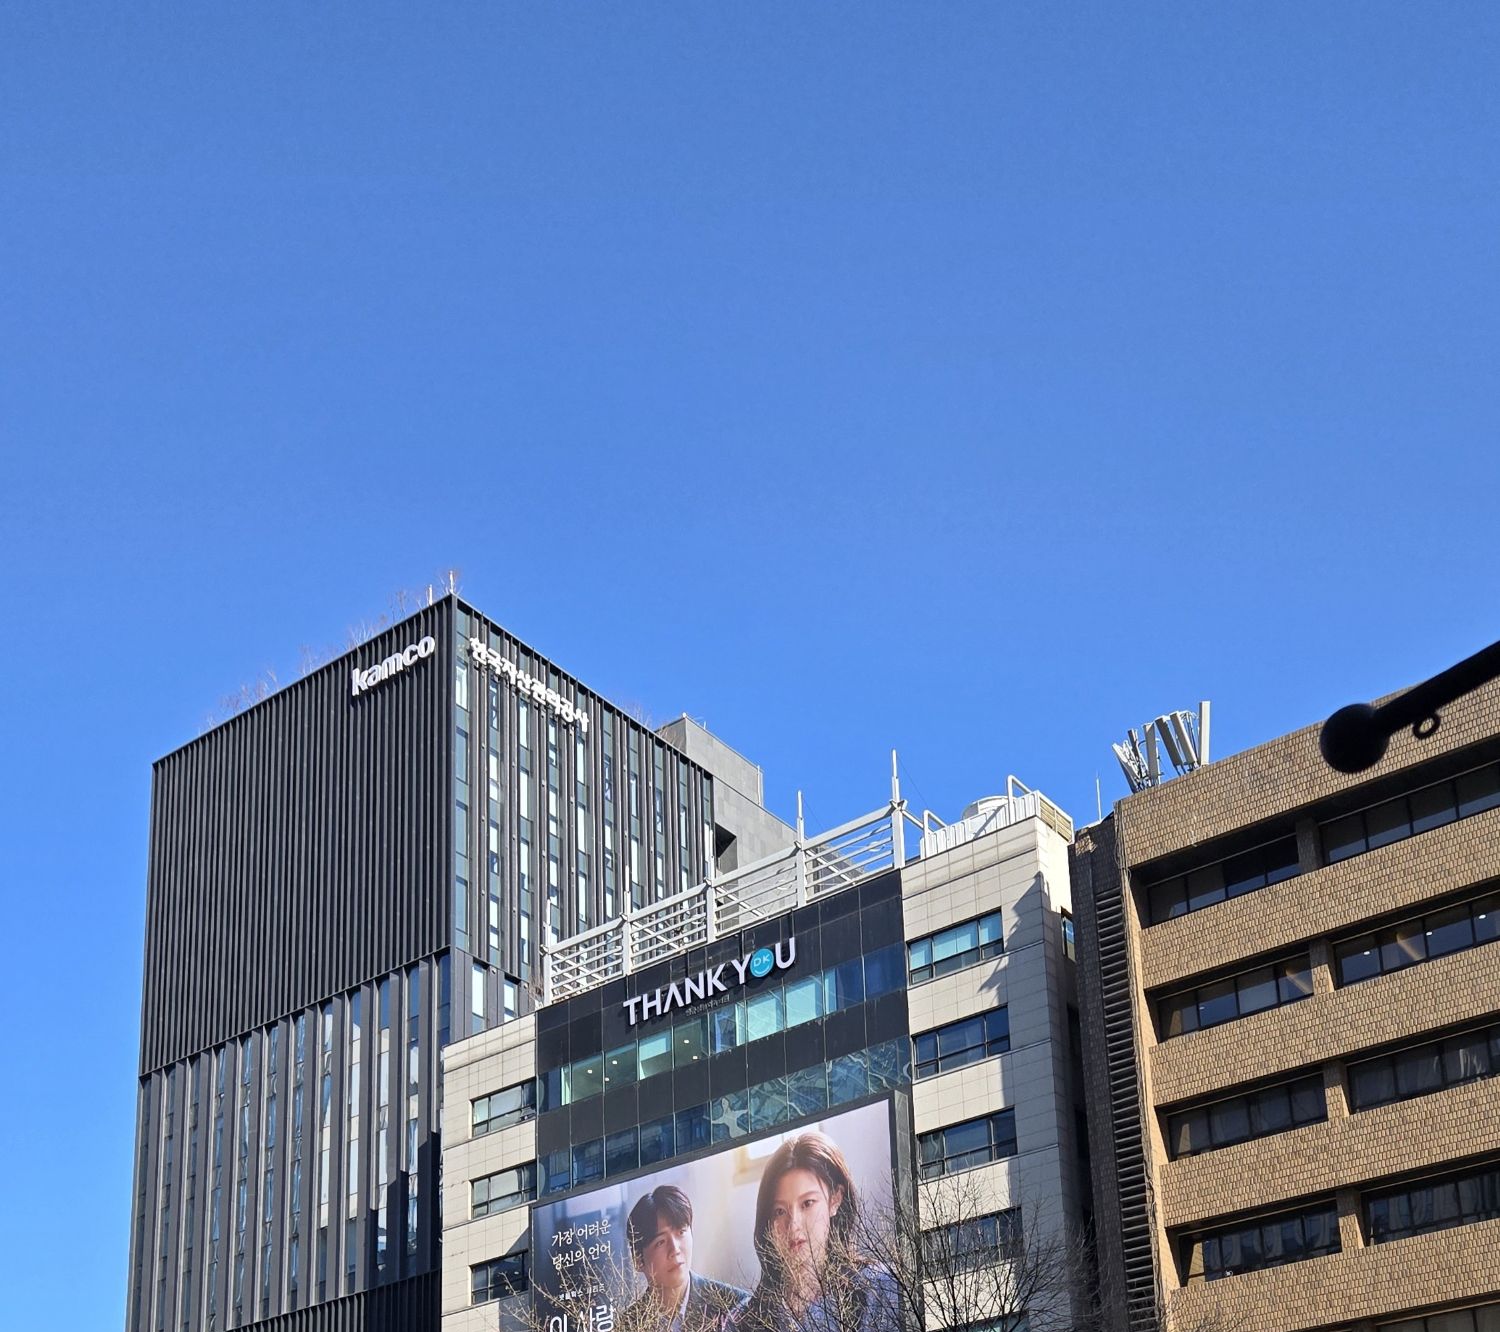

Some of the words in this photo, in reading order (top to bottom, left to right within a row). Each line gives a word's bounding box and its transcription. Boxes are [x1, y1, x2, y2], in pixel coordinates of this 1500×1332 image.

[352, 636, 436, 696] kamco
[469, 637, 590, 733] 한국자산관리공사
[623, 963, 728, 1026] THANK
[730, 937, 796, 985] YOU
[551, 1229, 574, 1247] 가장
[577, 1219, 612, 1240] 어려운
[552, 1248, 585, 1270] 당신의
[588, 1240, 611, 1260] 언어
